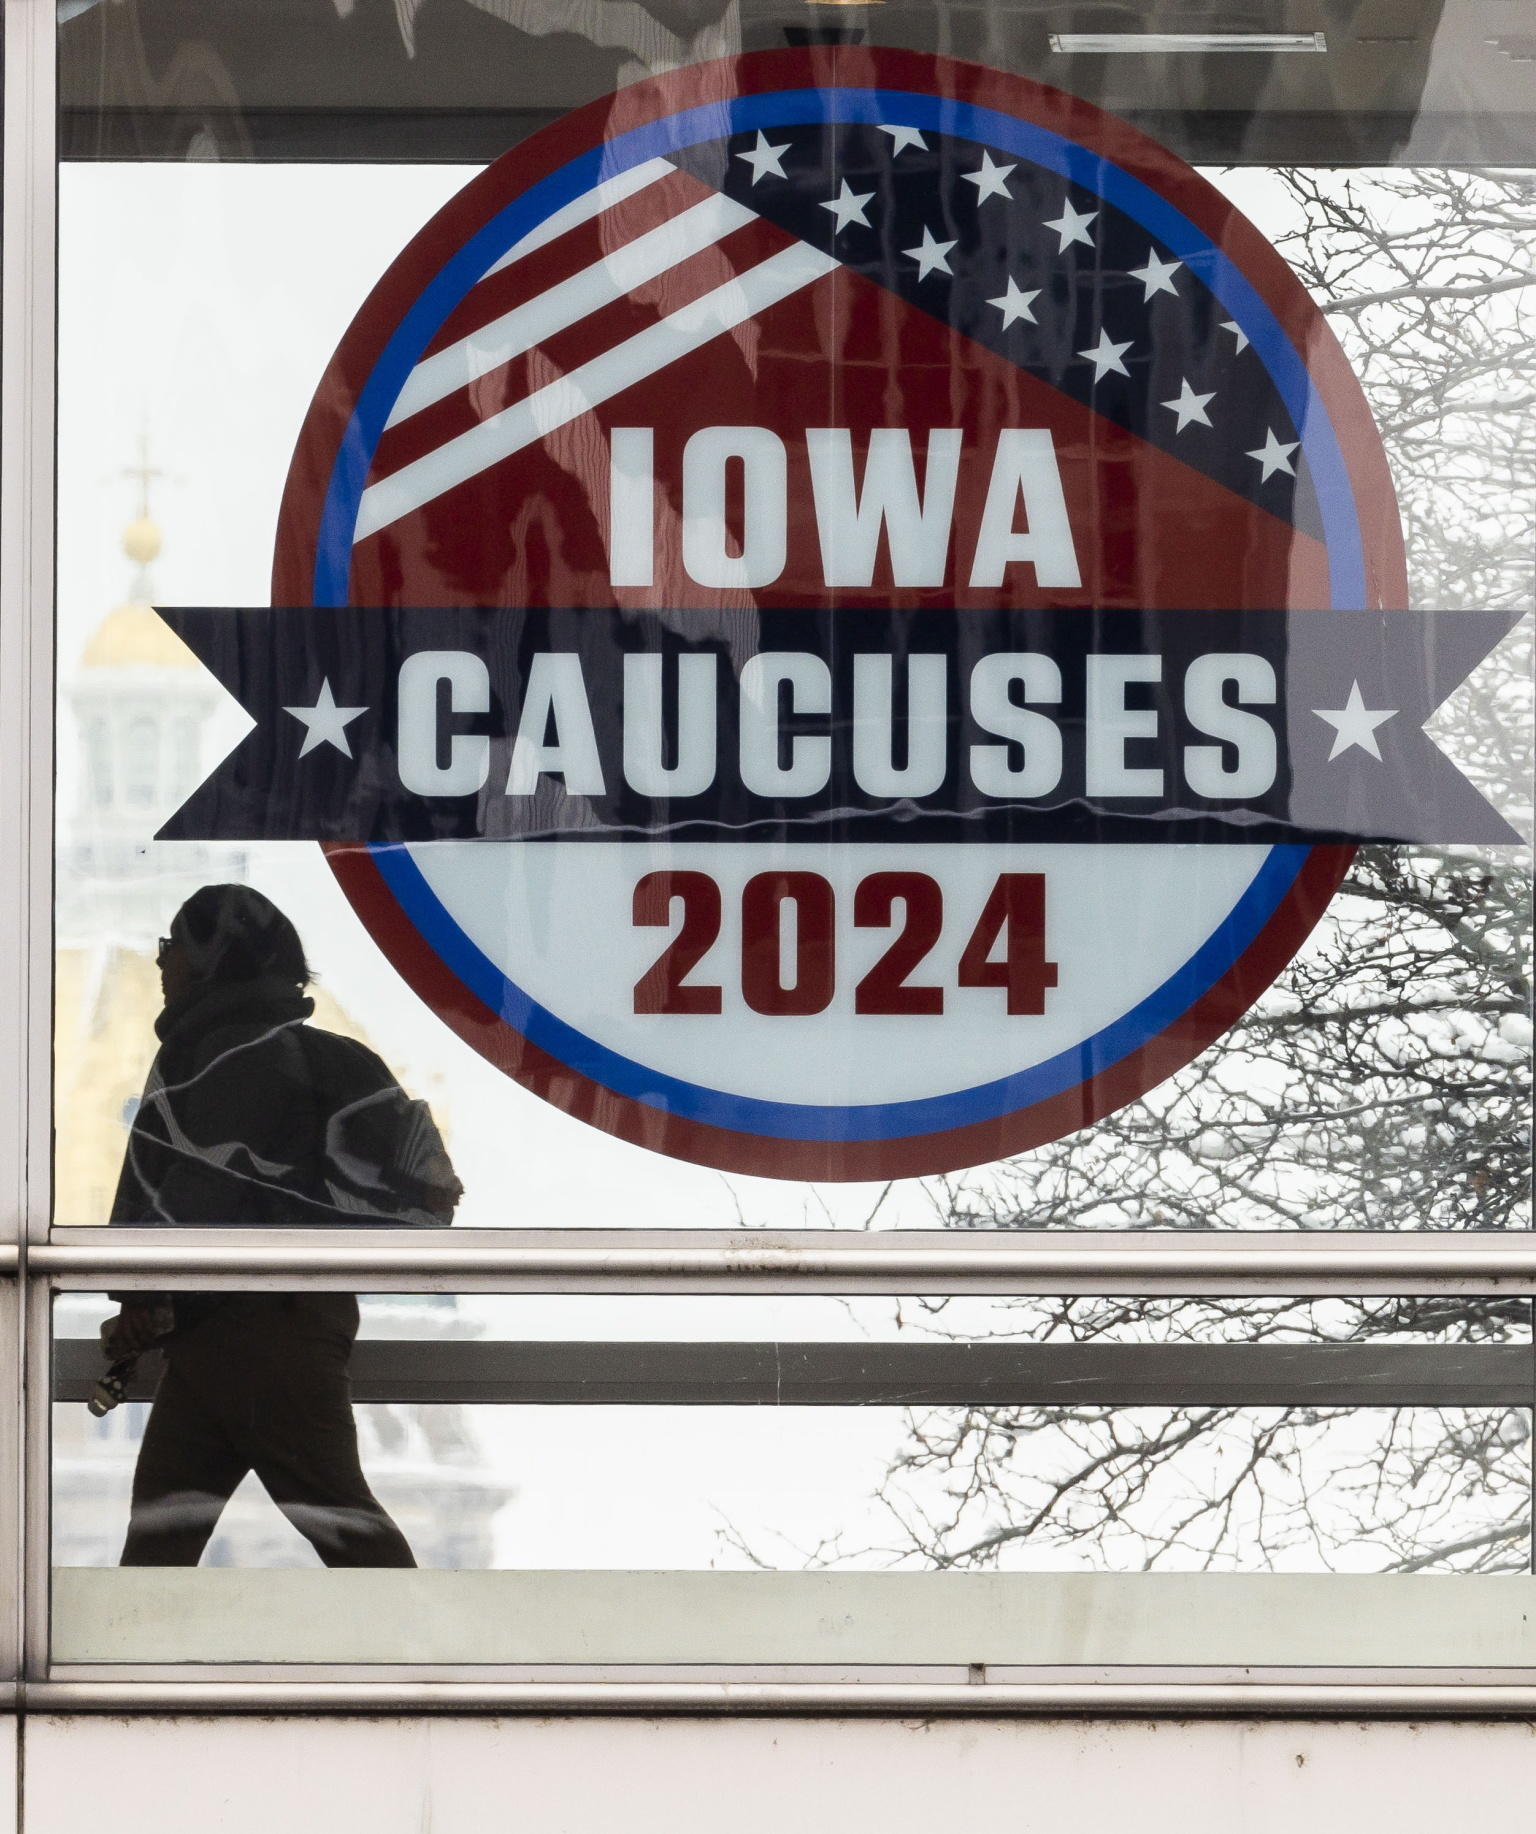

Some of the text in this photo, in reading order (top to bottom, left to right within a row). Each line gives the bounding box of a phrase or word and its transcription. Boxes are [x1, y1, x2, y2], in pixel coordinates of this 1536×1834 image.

[609, 426, 1082, 589] IOWA
[397, 650, 1278, 799] CAUCUSES
[633, 871, 1058, 1015] 2024
